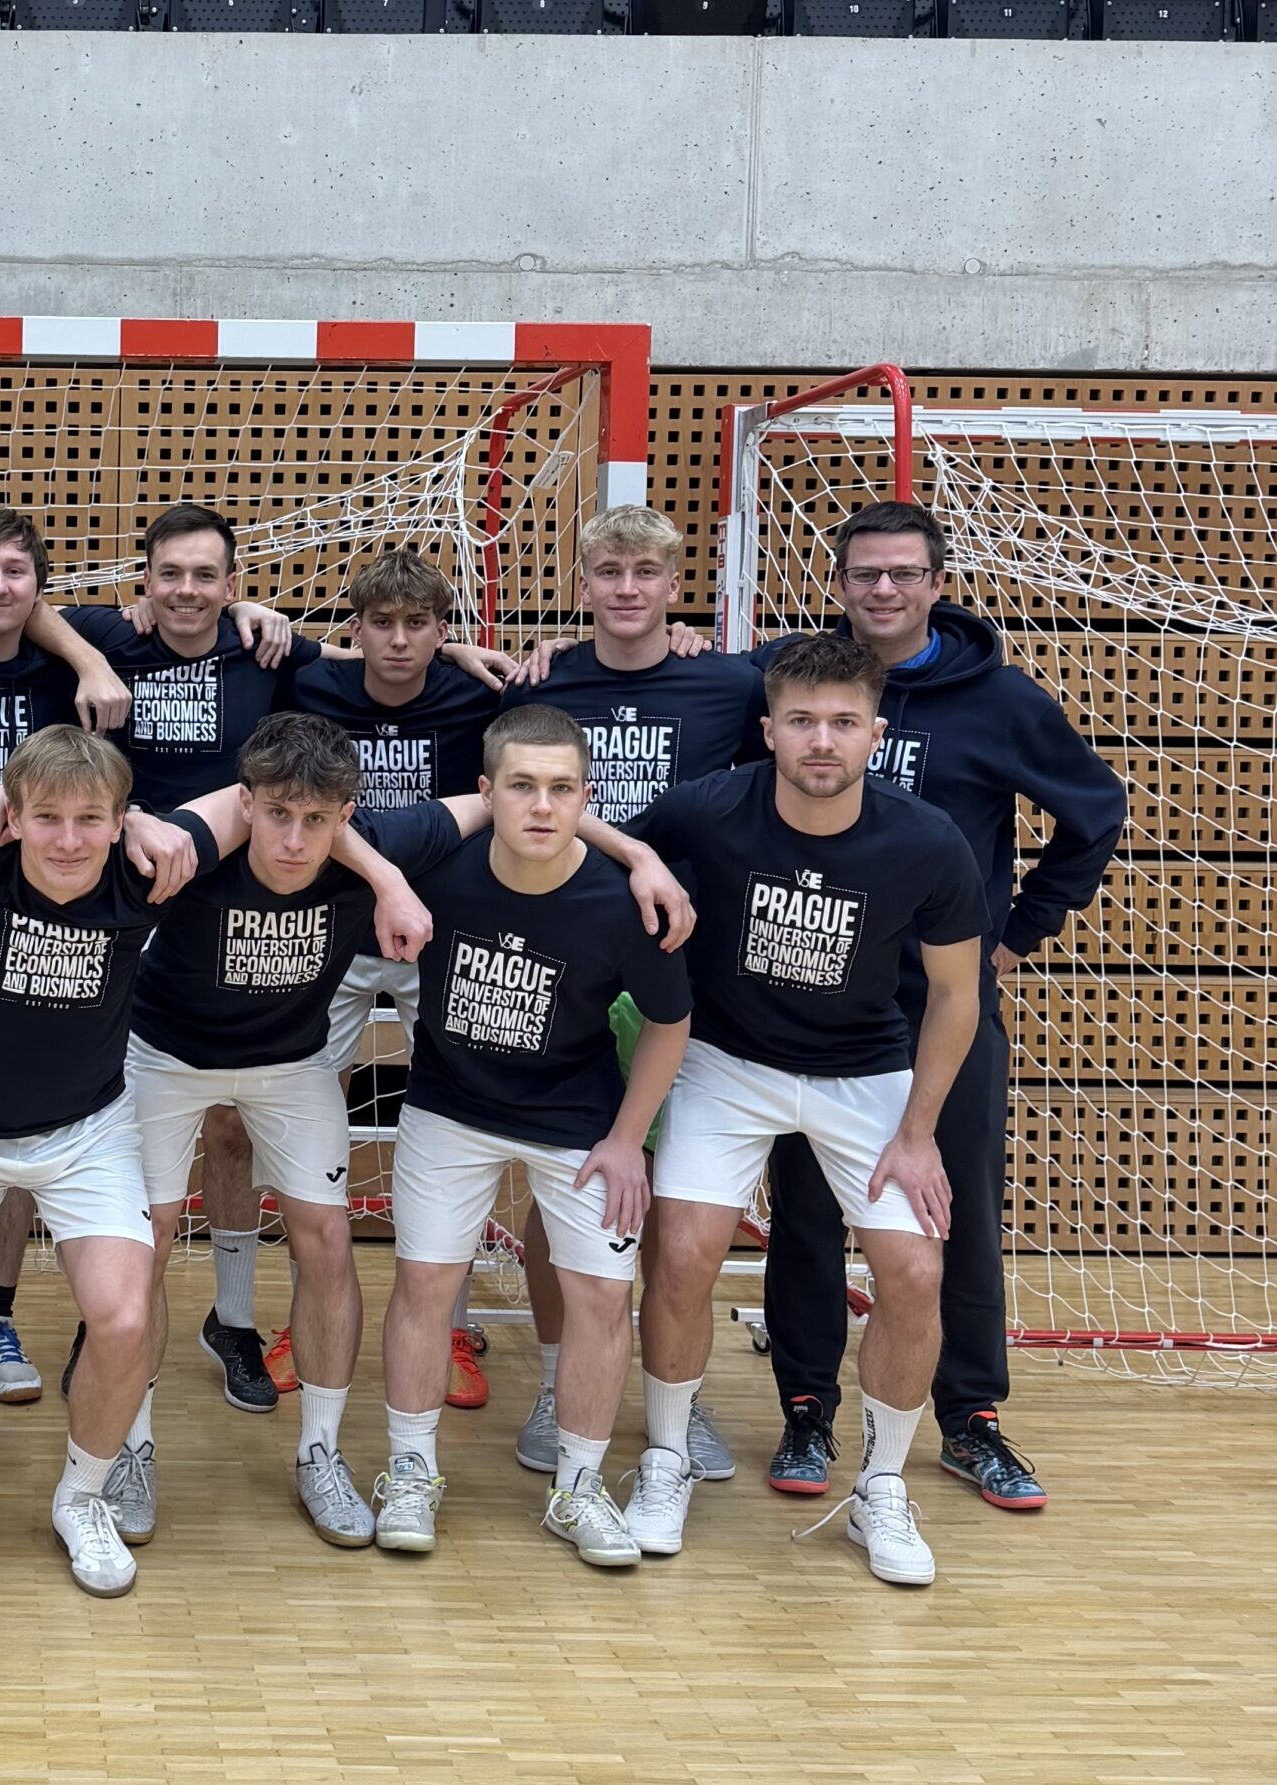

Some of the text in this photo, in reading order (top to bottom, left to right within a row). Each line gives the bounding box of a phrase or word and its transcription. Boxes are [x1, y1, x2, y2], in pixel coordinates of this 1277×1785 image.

[702, 1, 709, 10] 9
[849, 5, 859, 13] 10
[1003, 8, 1012, 17] 11
[1158, 10, 1168, 18] 12
[134, 682, 217, 701] UNIVERSITY OF
[134, 699, 217, 722] ECONOMICS
[134, 721, 217, 742] AND BUSINESS
[419, 773, 431, 789] OF
[588, 761, 670, 781] NIVERSITY OF
[586, 780, 669, 804] CONOMICS
[227, 904, 329, 939] PRAGUE
[750, 883, 859, 937] PRAGUE
[9, 929, 93, 955] UNIVERSITY
[226, 938, 327, 956] UNIVERSITY OF
[749, 916, 853, 954] UNIVERSITY OF
[5, 946, 104, 979] ECONOMICS
[225, 953, 324, 974] ECONOMICS
[746, 932, 848, 972] ECONOMICS
[224, 969, 320, 986] AND BUSINESS
[454, 942, 556, 997] PRAGUE
[745, 954, 843, 986] AND BUSINESS
[2, 971, 102, 999] AND BUSINESS
[451, 974, 551, 1016] UNIVERSITY OF
[447, 992, 546, 1035] ECONOMICS
[445, 1014, 542, 1051] AND BUSINESS
